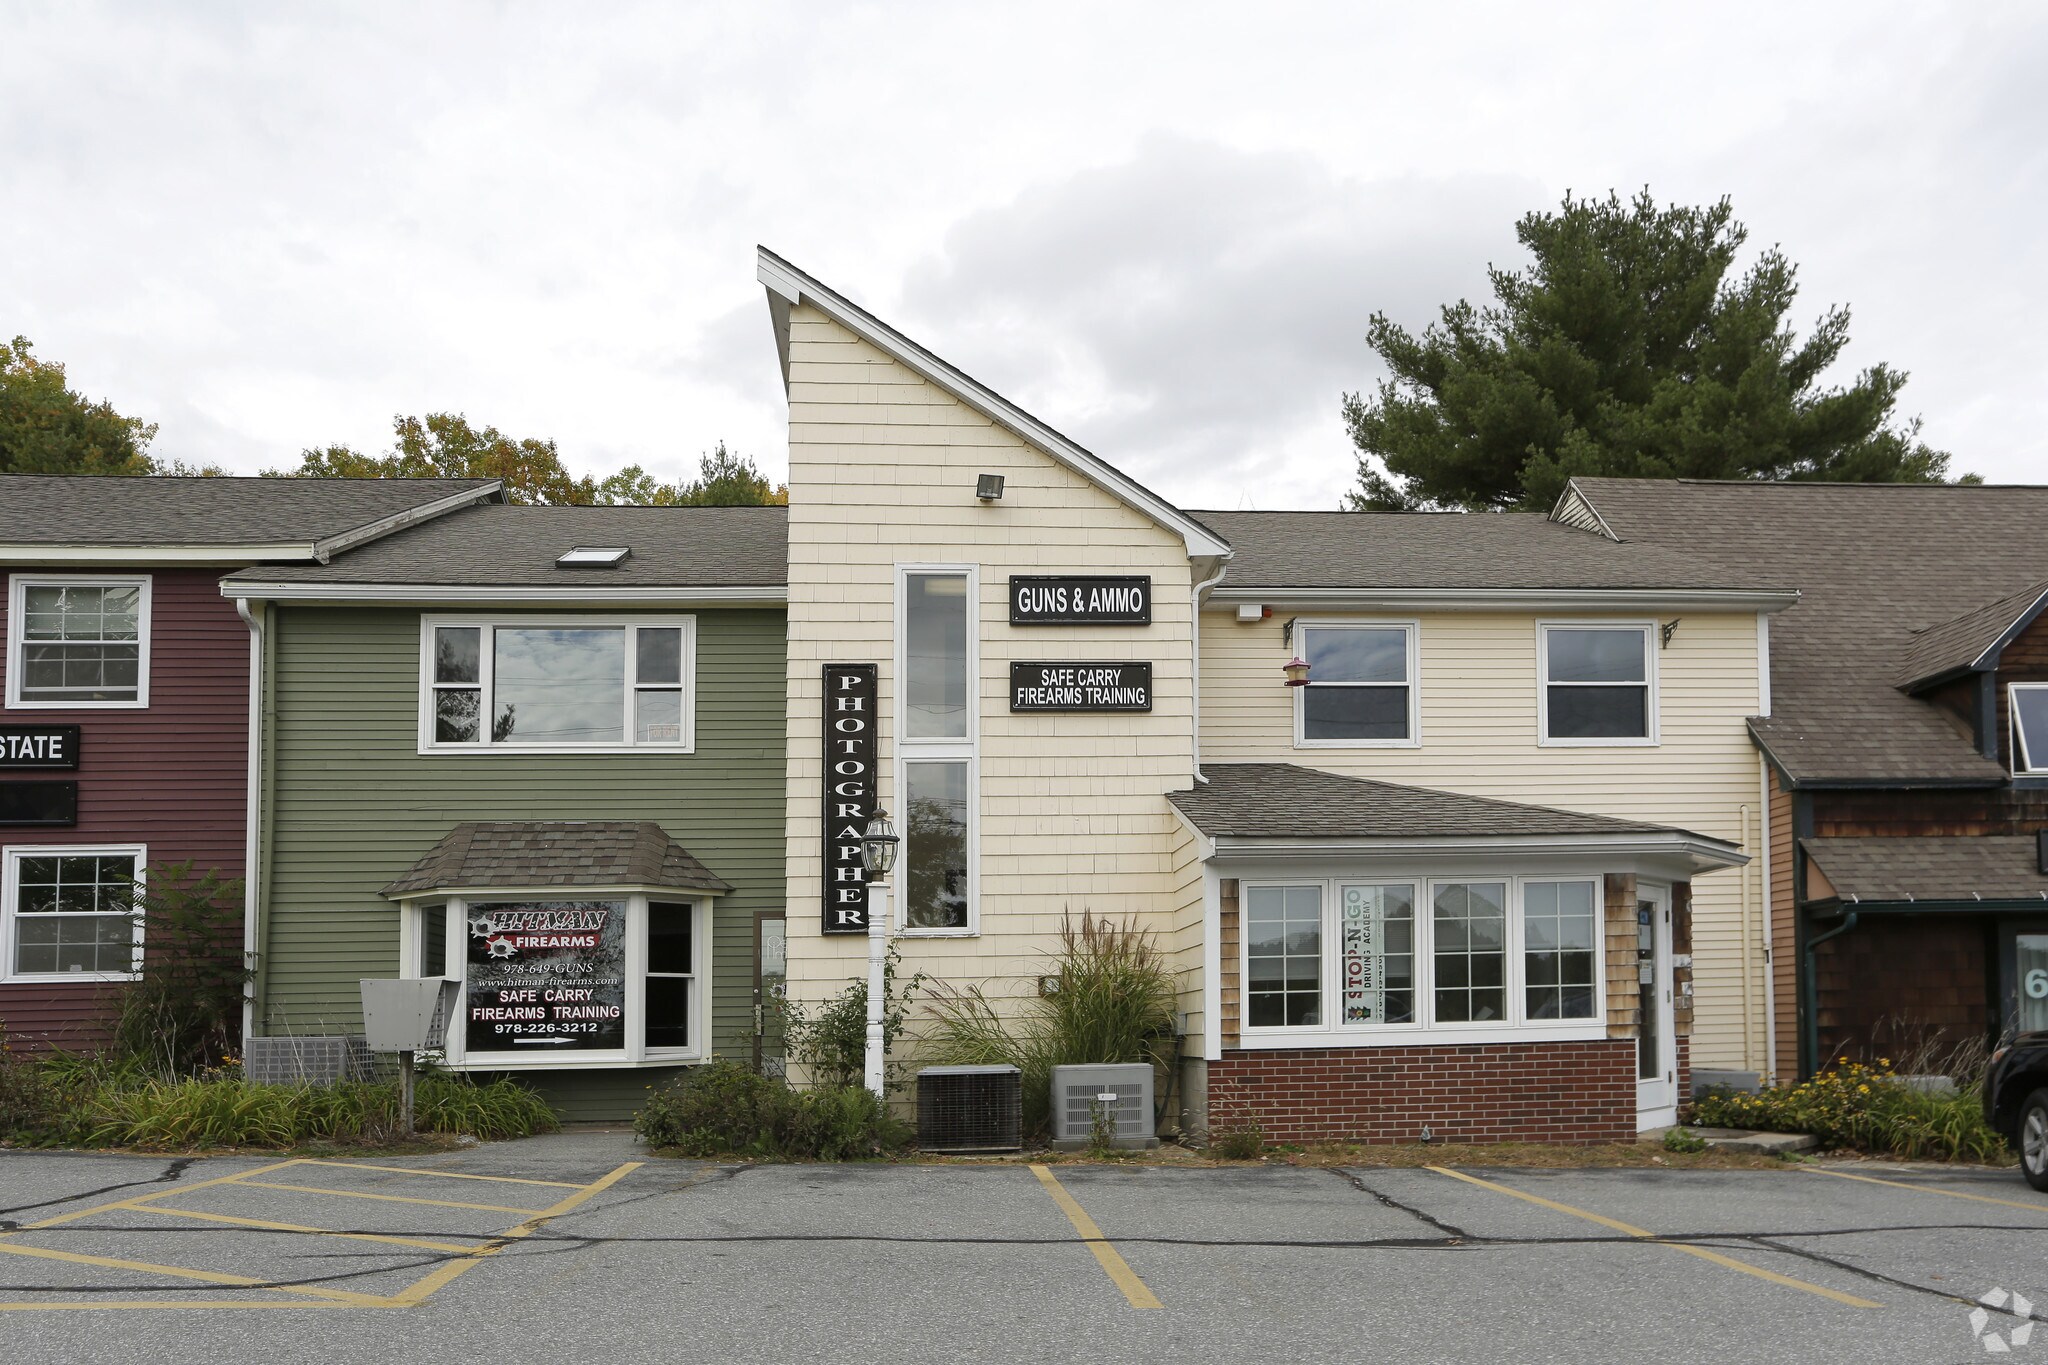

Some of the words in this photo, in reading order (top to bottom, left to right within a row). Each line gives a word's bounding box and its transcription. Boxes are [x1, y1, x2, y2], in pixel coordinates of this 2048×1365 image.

[1018, 587, 1068, 613] GUNS
[1072, 587, 1085, 613] &
[1088, 587, 1143, 613] AMMO
[1041, 669, 1074, 686] SAFE
[1077, 669, 1121, 686] CARRY
[1017, 687, 1082, 704] FIREARMS
[1086, 687, 1145, 704] TRAINING
[834, 675, 866, 925] PHOTOGRAPHER
[493, 910, 607, 932] HITMAN
[1363, 900, 1371, 944] ACADEMY
[516, 936, 595, 948] FIREARMS
[503, 963, 594, 975] 978-649-GUNS
[478, 976, 618, 987] www.hitman-firearms.com
[499, 989, 537, 1003] SAFE
[544, 988, 594, 1002] CARRY
[472, 1006, 546, 1020] FIREARMS
[553, 1005, 620, 1019] TRAINING
[494, 1022, 598, 1034] 978-226-3212
